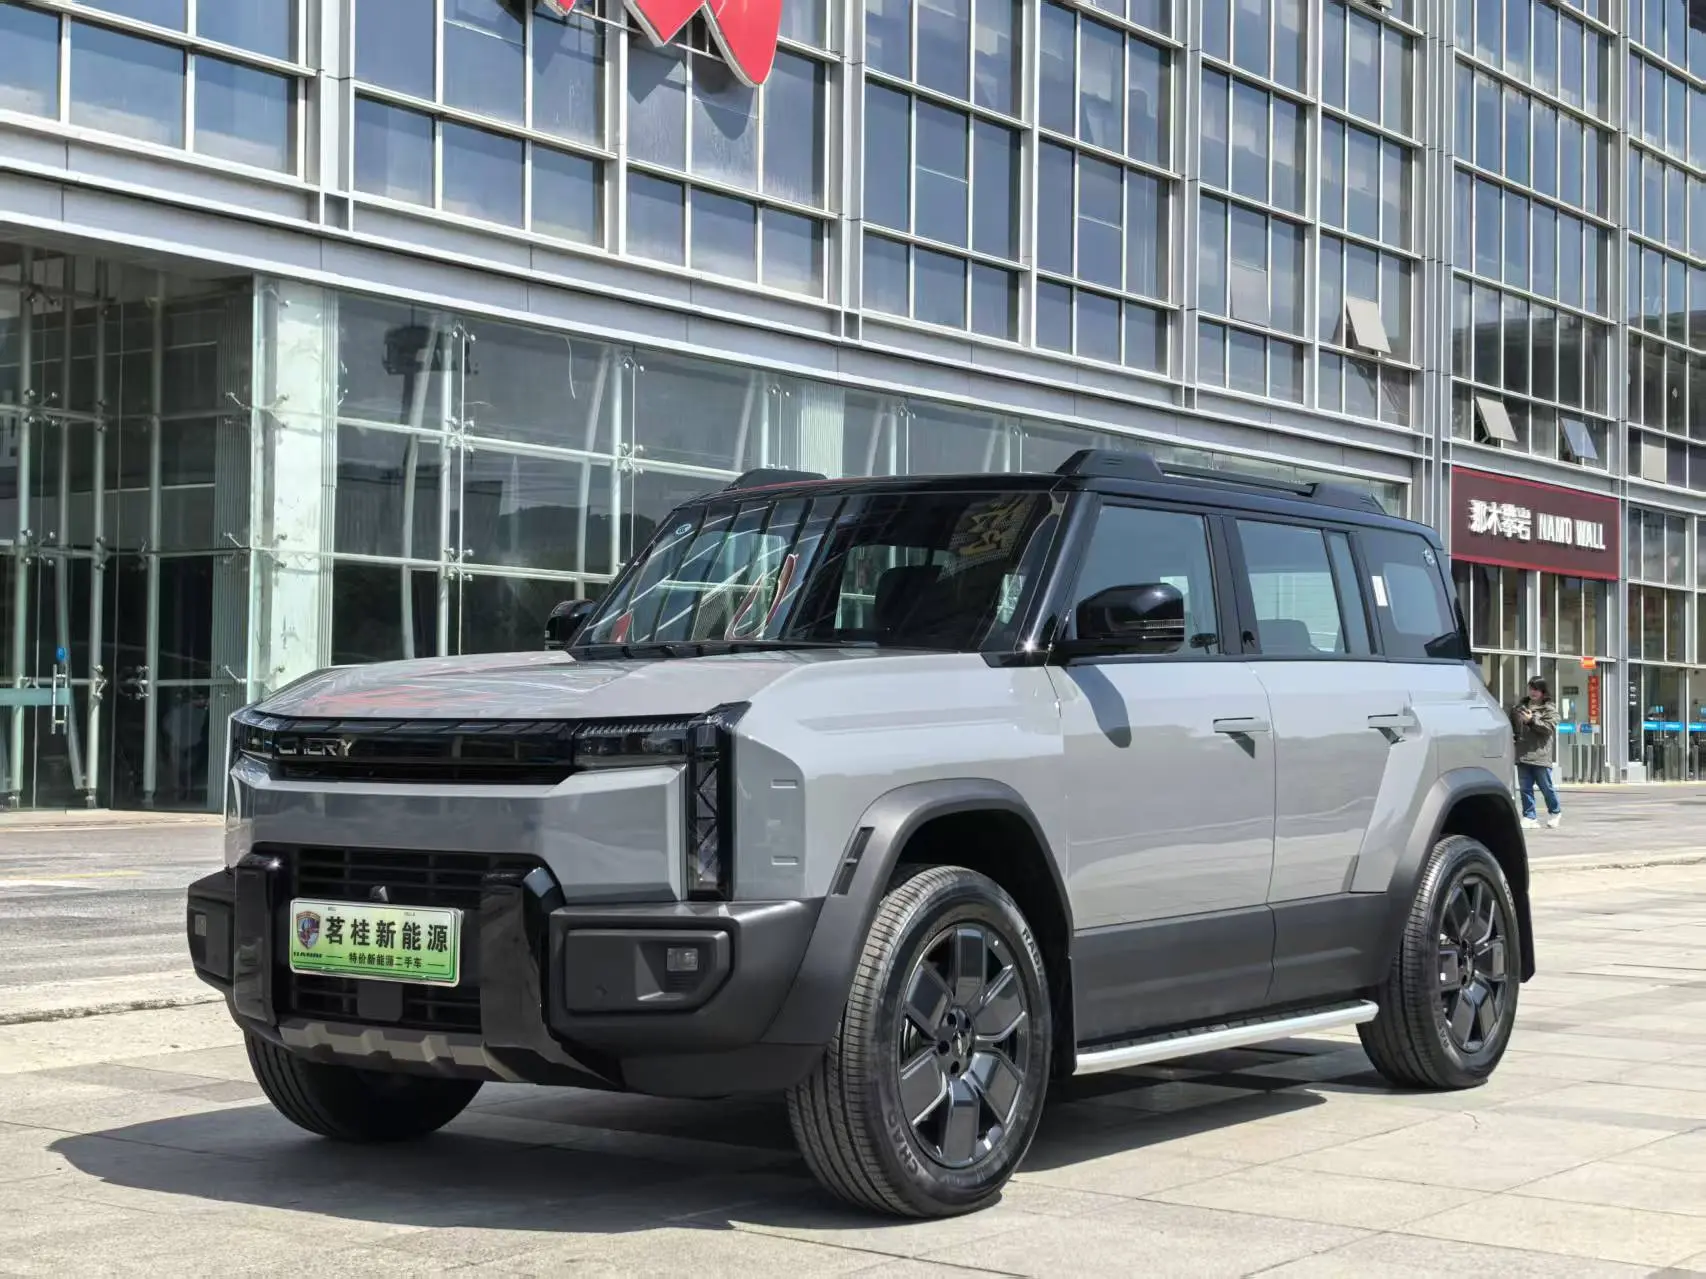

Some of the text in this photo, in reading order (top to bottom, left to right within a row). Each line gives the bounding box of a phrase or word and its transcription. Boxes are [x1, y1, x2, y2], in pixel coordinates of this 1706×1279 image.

[1538, 513, 1606, 550] NAMO WALL
[325, 916, 449, 953] 茗桂新能源
[348, 952, 423, 969] 特价新能源二手车
